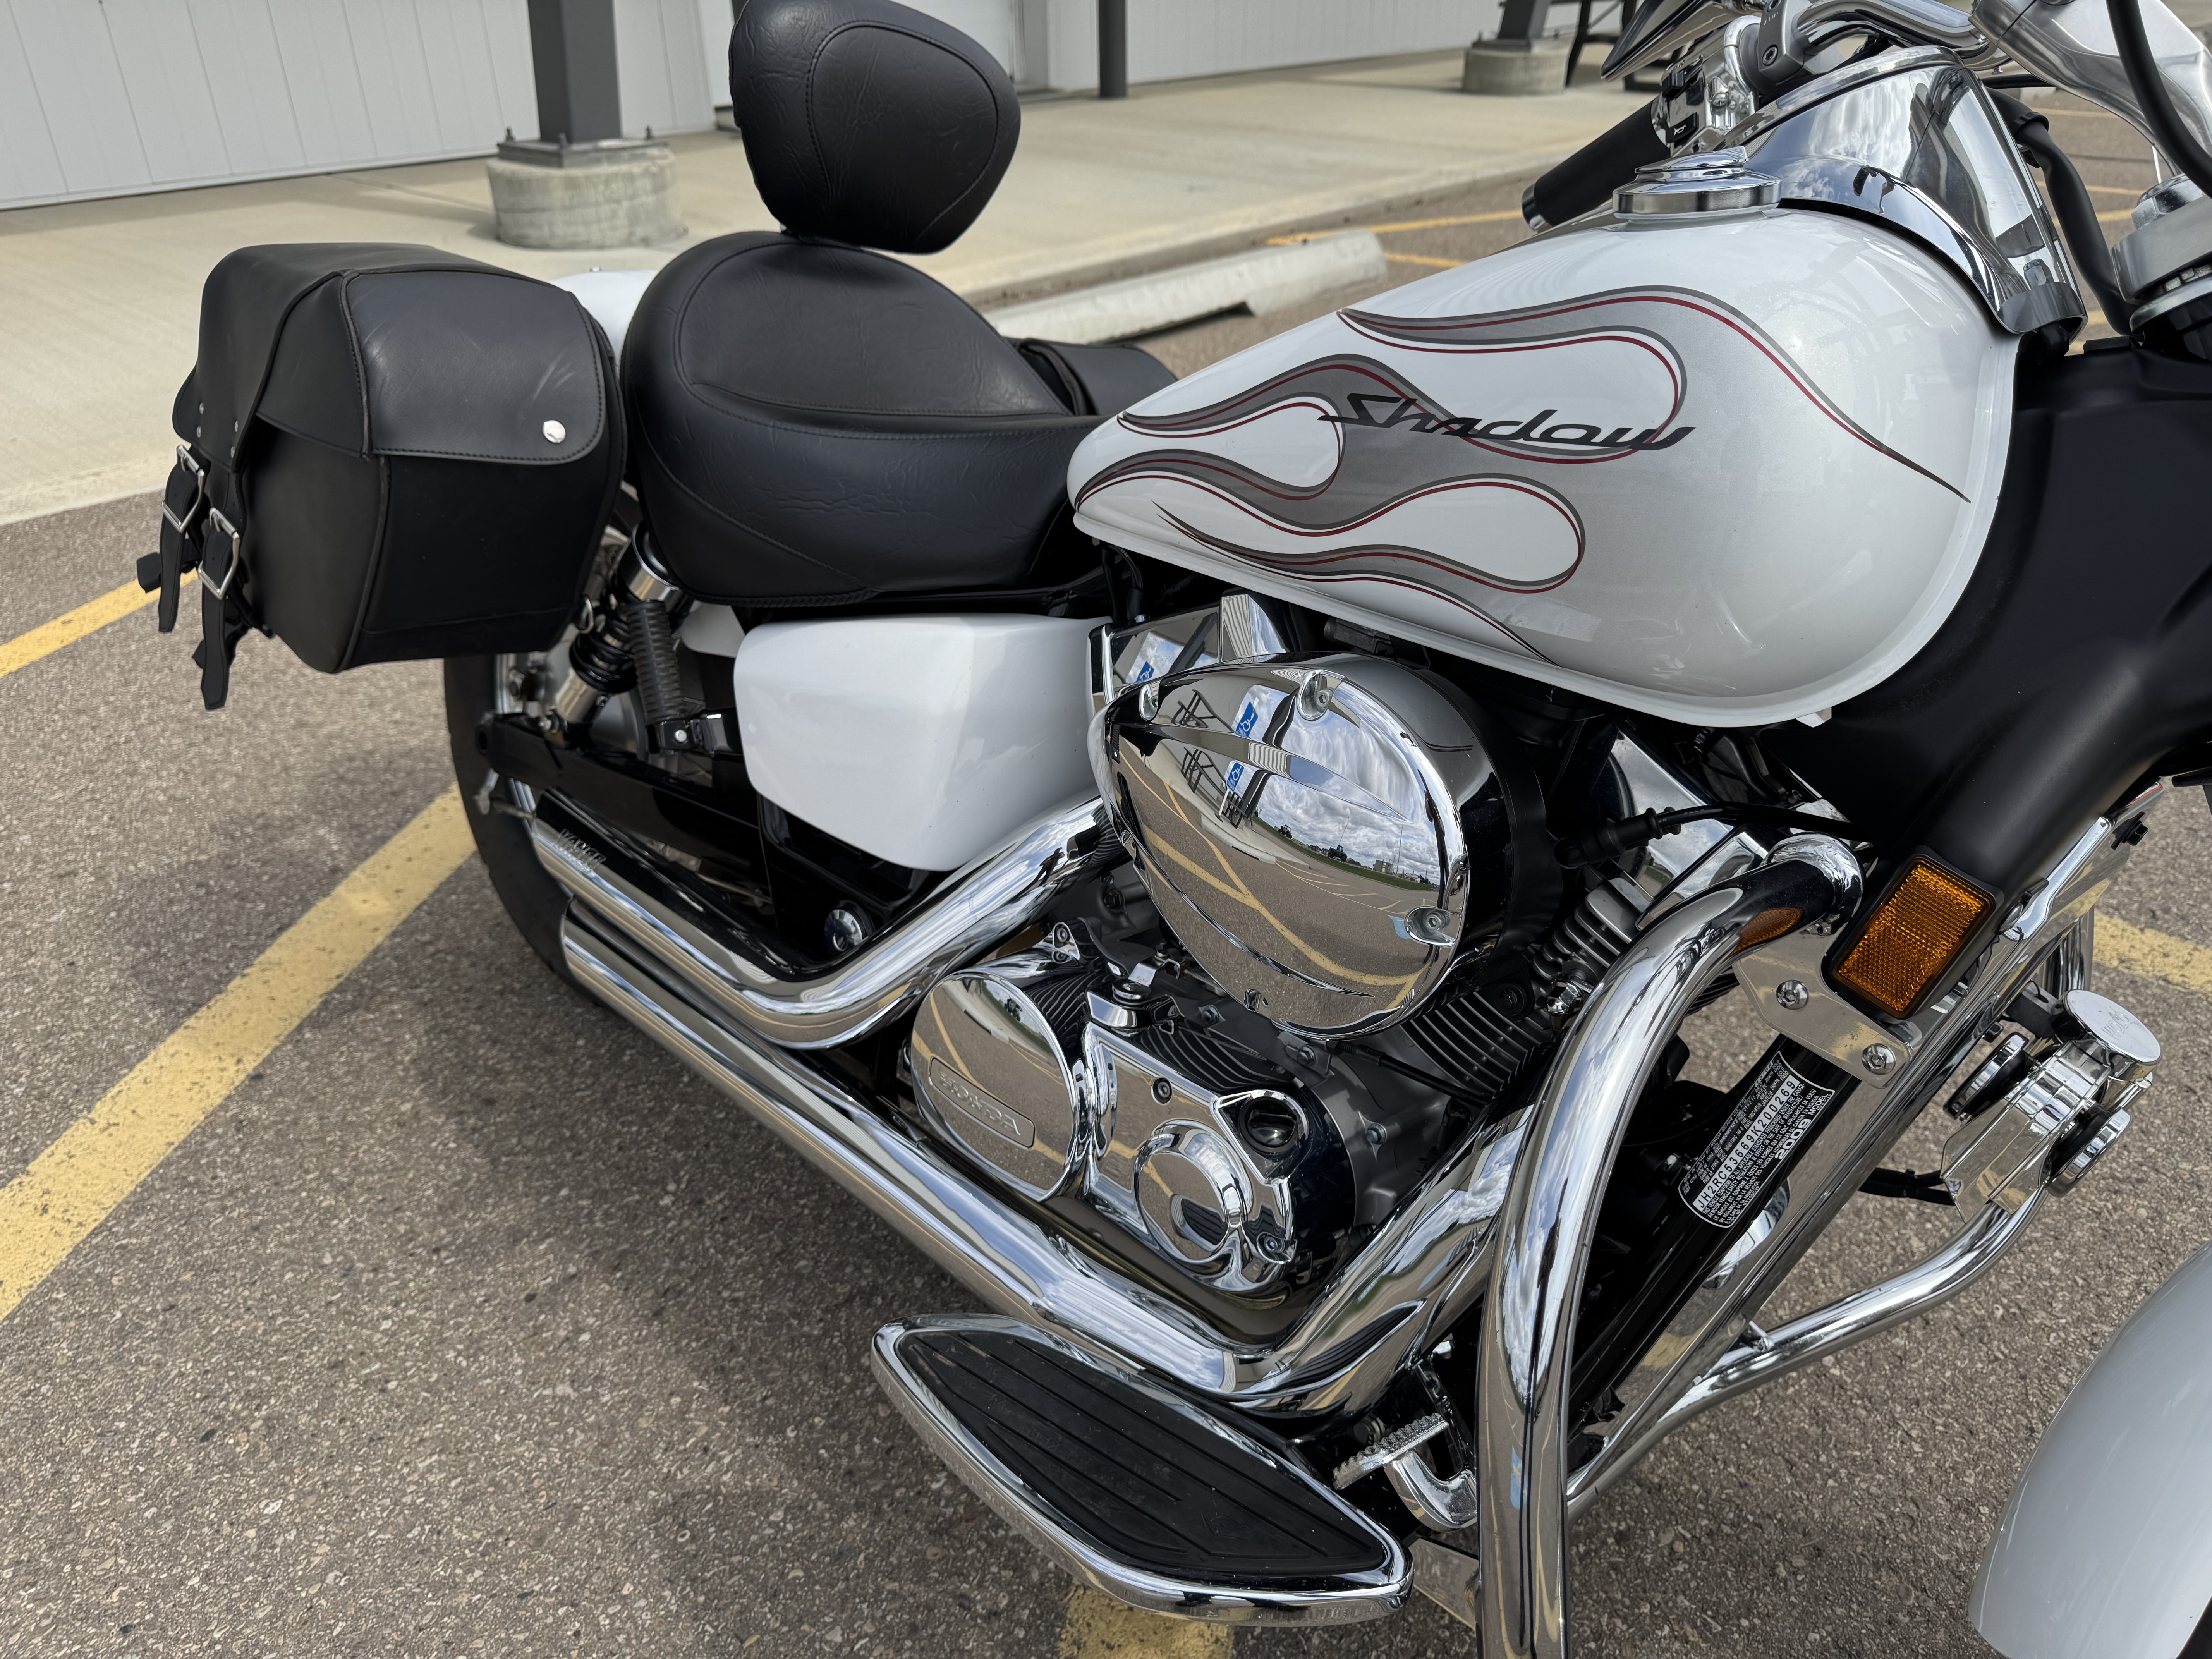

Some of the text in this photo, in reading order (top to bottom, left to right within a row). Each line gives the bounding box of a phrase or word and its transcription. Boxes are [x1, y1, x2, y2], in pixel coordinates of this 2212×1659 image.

[1317, 393, 1696, 450] Shadow
[940, 1070, 1021, 1136] HONDA
[1774, 1117, 1811, 1159] 2009
[1807, 1094, 1828, 1114] MODEL
[1696, 1080, 1796, 1208] JH2RC53669K200269
